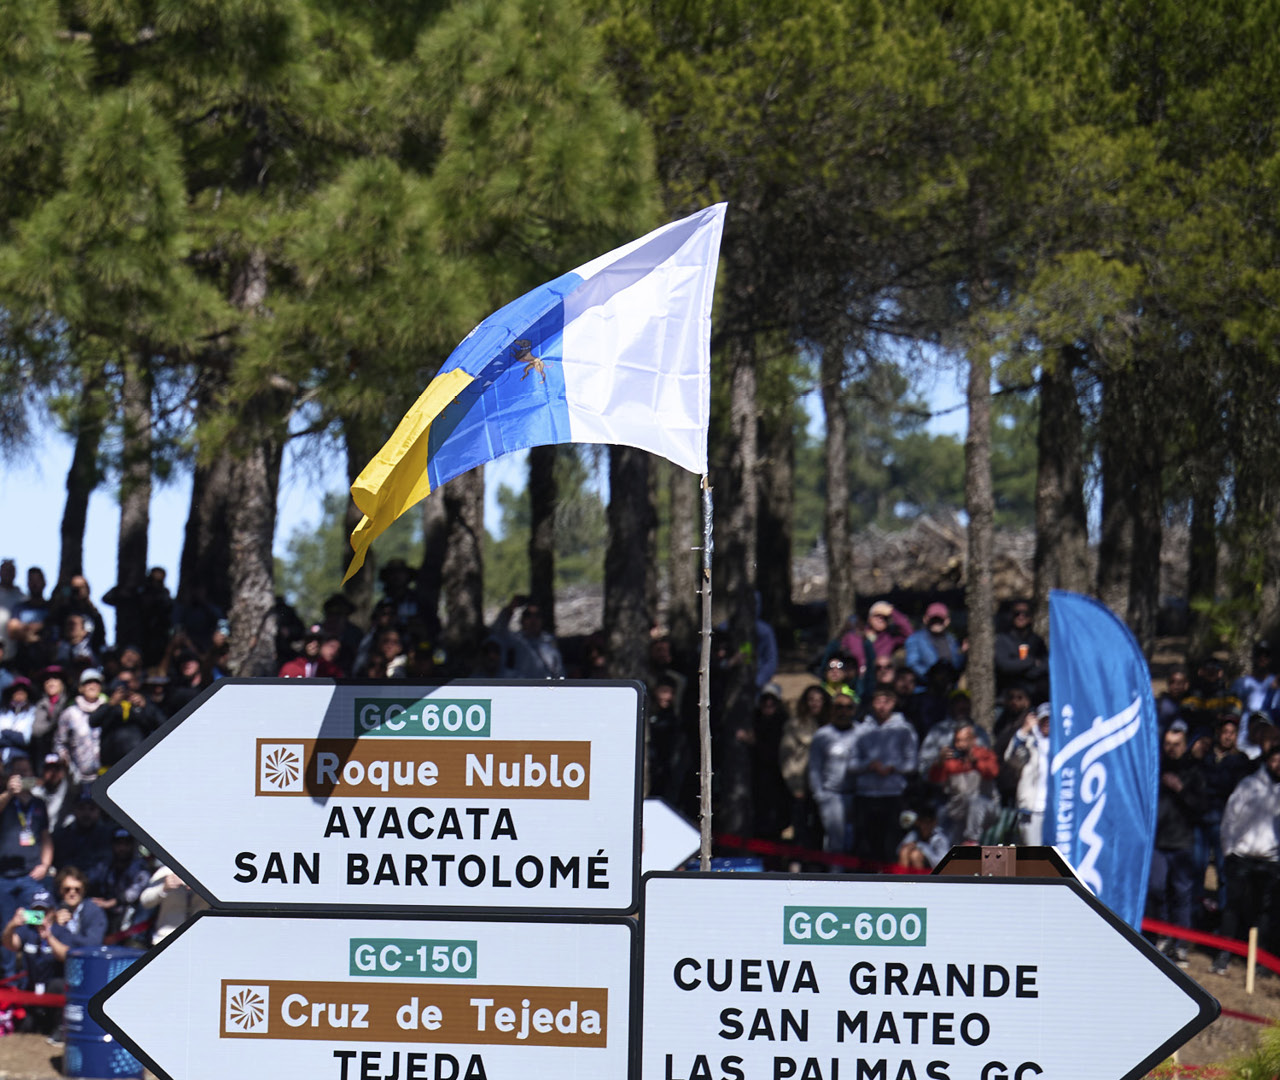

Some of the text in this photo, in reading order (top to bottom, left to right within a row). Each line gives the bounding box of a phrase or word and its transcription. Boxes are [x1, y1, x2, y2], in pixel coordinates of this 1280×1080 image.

[359, 703, 486, 732] GC-600
[316, 751, 586, 790] Roque Nublo
[323, 803, 518, 841] AYACATA
[233, 849, 610, 890] SAN BARTOLOMÉ
[788, 911, 922, 941] GC-600
[354, 943, 473, 973] GC-150
[673, 957, 1039, 999] CUEVA GRANDE
[281, 993, 602, 1039] Cruz de Tejeda
[718, 1007, 991, 1047] SAN MATEO
